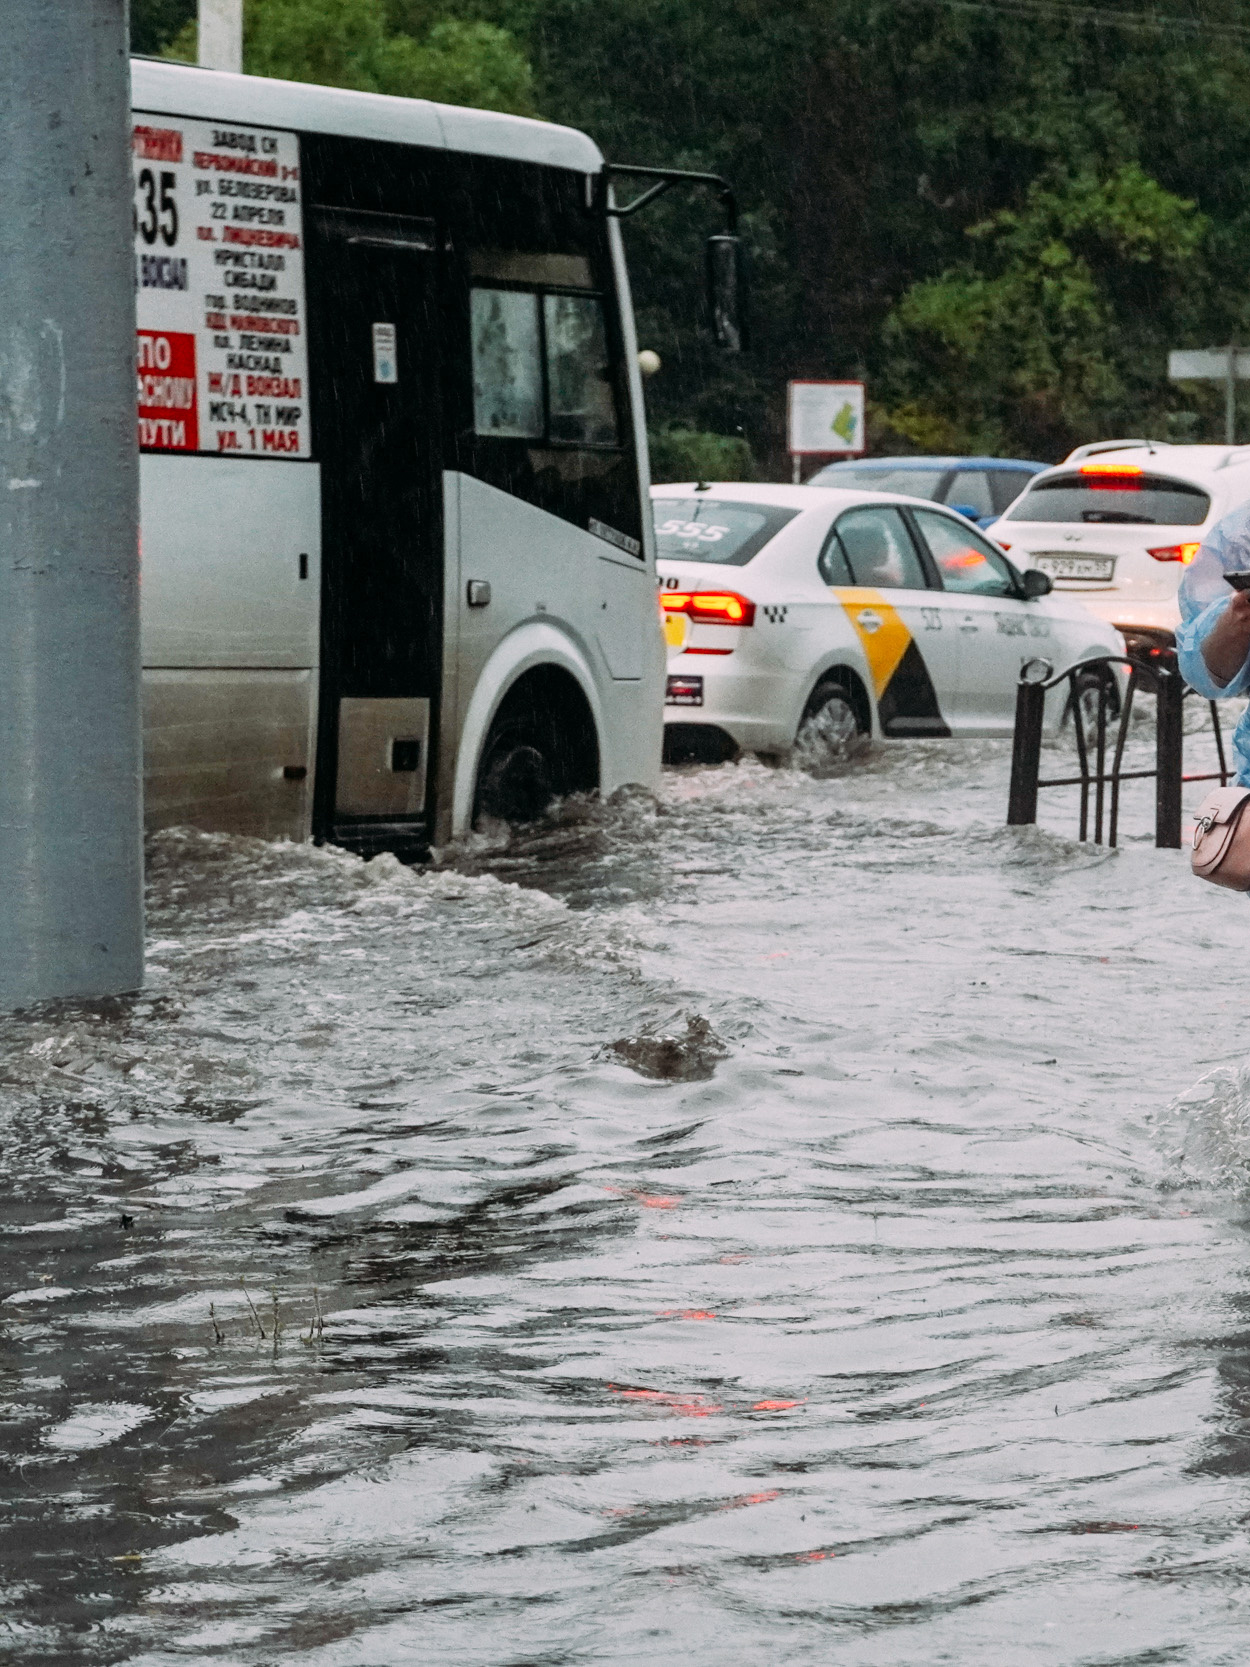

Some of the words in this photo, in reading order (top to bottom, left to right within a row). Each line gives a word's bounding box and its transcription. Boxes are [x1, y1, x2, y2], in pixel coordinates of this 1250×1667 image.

[211, 130, 256, 153] ЗАВОД
[133, 168, 178, 247] 35
[210, 201, 227, 220] 22
[232, 204, 285, 226] АПРЕЛЯ
[137, 335, 171, 370] ПО
[239, 334, 293, 354] ЛЕНИНА
[208, 371, 243, 399] Ж/Д
[275, 405, 301, 427] МИР
[217, 430, 243, 454] ул.
[248, 428, 256, 450] 1
[262, 429, 299, 453] МАЯ
